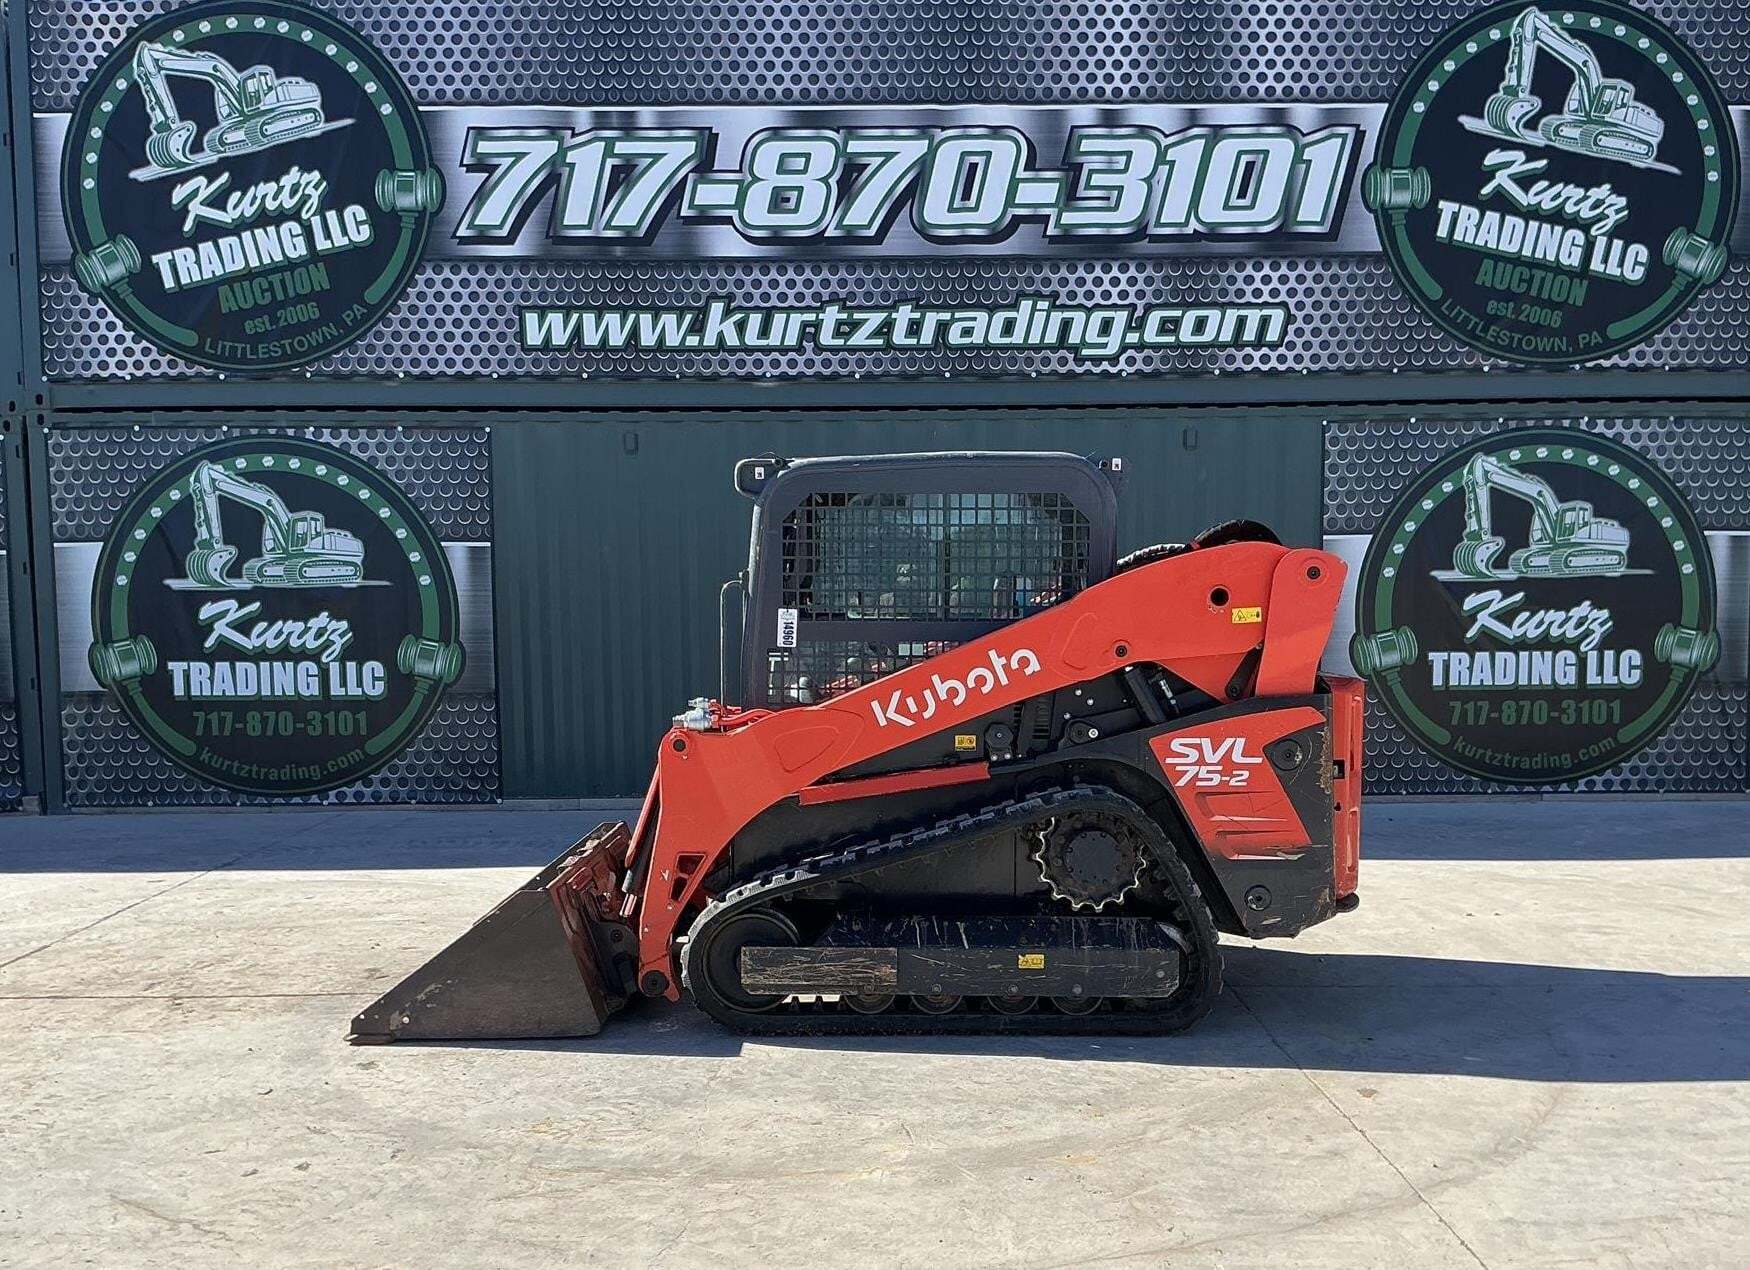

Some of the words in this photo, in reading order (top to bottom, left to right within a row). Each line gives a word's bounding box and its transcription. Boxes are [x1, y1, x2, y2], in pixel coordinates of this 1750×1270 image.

[171, 166, 327, 237] Kurtz
[456, 126, 1360, 240] 717-870-3101
[1480, 148, 1631, 236] Kurtz
[151, 221, 308, 290] TRADING
[311, 204, 374, 251] LLC
[1435, 199, 1587, 269] TRADING
[1588, 235, 1650, 283] LLC
[217, 262, 331, 314] AUCTION
[1475, 258, 1589, 307] AUCTION
[204, 322, 345, 359] LITTLESTOWN,
[342, 303, 368, 326] PA
[244, 314, 276, 335] est.
[277, 302, 320, 327] 2006
[522, 298, 1287, 360] www.kurtztrading.com
[1441, 298, 1573, 353] LITTLESTOWN,
[1578, 331, 1603, 349] PA
[1486, 300, 1515, 319] est.
[1518, 303, 1563, 329] 2006
[199, 599, 353, 662] Kurtz
[1461, 590, 1615, 652] Kurtz
[167, 661, 320, 696] TRADING
[327, 661, 386, 696] LLC
[871, 646, 1041, 728] Kubota
[1429, 651, 1578, 687] TRADING
[1584, 650, 1643, 685] LLC
[193, 710, 367, 737] 717-870-3101
[1449, 699, 1622, 726] 717-870-3101
[200, 747, 366, 780] kurtztrading.com
[1165, 737, 1263, 764] SVL
[1174, 765, 1250, 787] 75-2
[1453, 736, 1616, 769] kurtztrading.com
